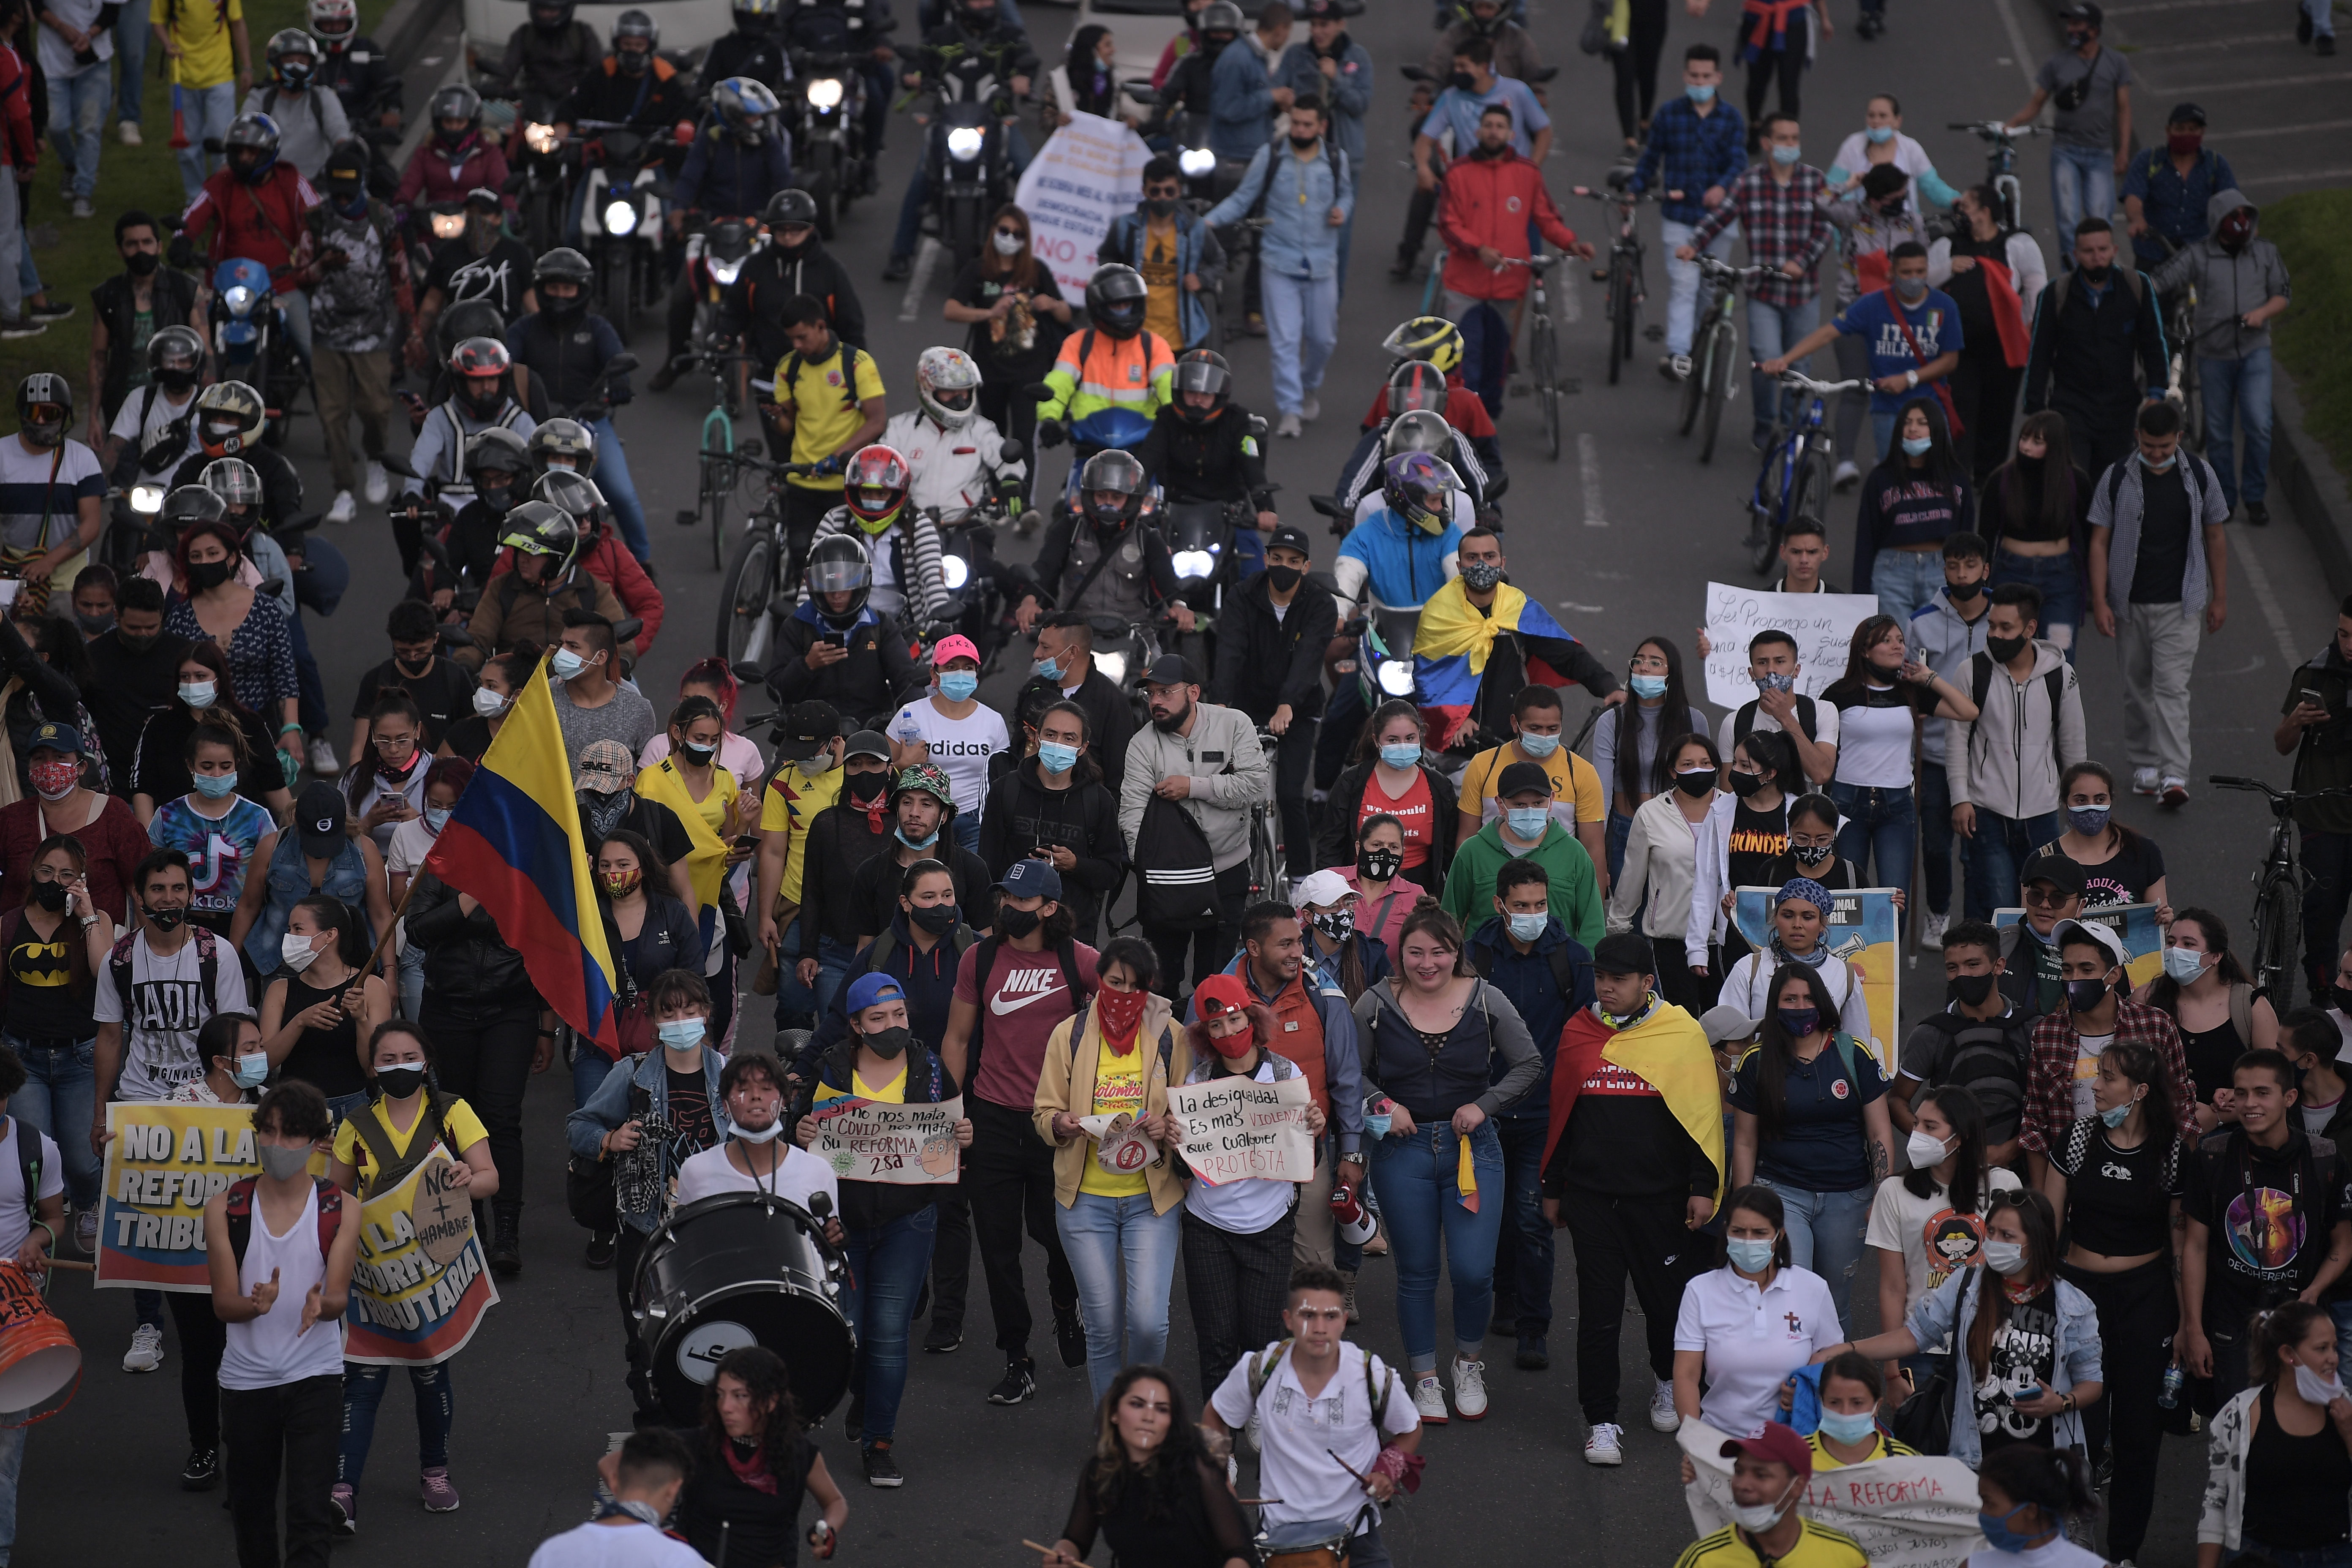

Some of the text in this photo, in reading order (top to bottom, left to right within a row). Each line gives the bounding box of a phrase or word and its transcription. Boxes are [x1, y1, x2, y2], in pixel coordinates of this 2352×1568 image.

[1034, 234, 1077, 263] NO
[1366, 804, 1382, 814] we
[1002, 969, 1057, 992] NIKE
[143, 983, 197, 1029] ADI
[828, 1097, 946, 1124] Si no nos mata
[1179, 1089, 1279, 1114] La desigualdad
[819, 1117, 955, 1136] el COVID nos mata
[1190, 1119, 1207, 1135] Es
[1249, 1109, 1303, 1126] VIOLENTA
[123, 1124, 256, 1163] NO A LA
[850, 1137, 918, 1154] REFORMA
[1204, 1150, 1285, 1178] PROTESTA
[425, 1163, 453, 1197] NO
[114, 1211, 207, 1251] TRIBU
[419, 1216, 468, 1247] HAMBRE
[351, 1245, 481, 1331] TRIBUTARIA
[1849, 1477, 1944, 1507] REFORMA
